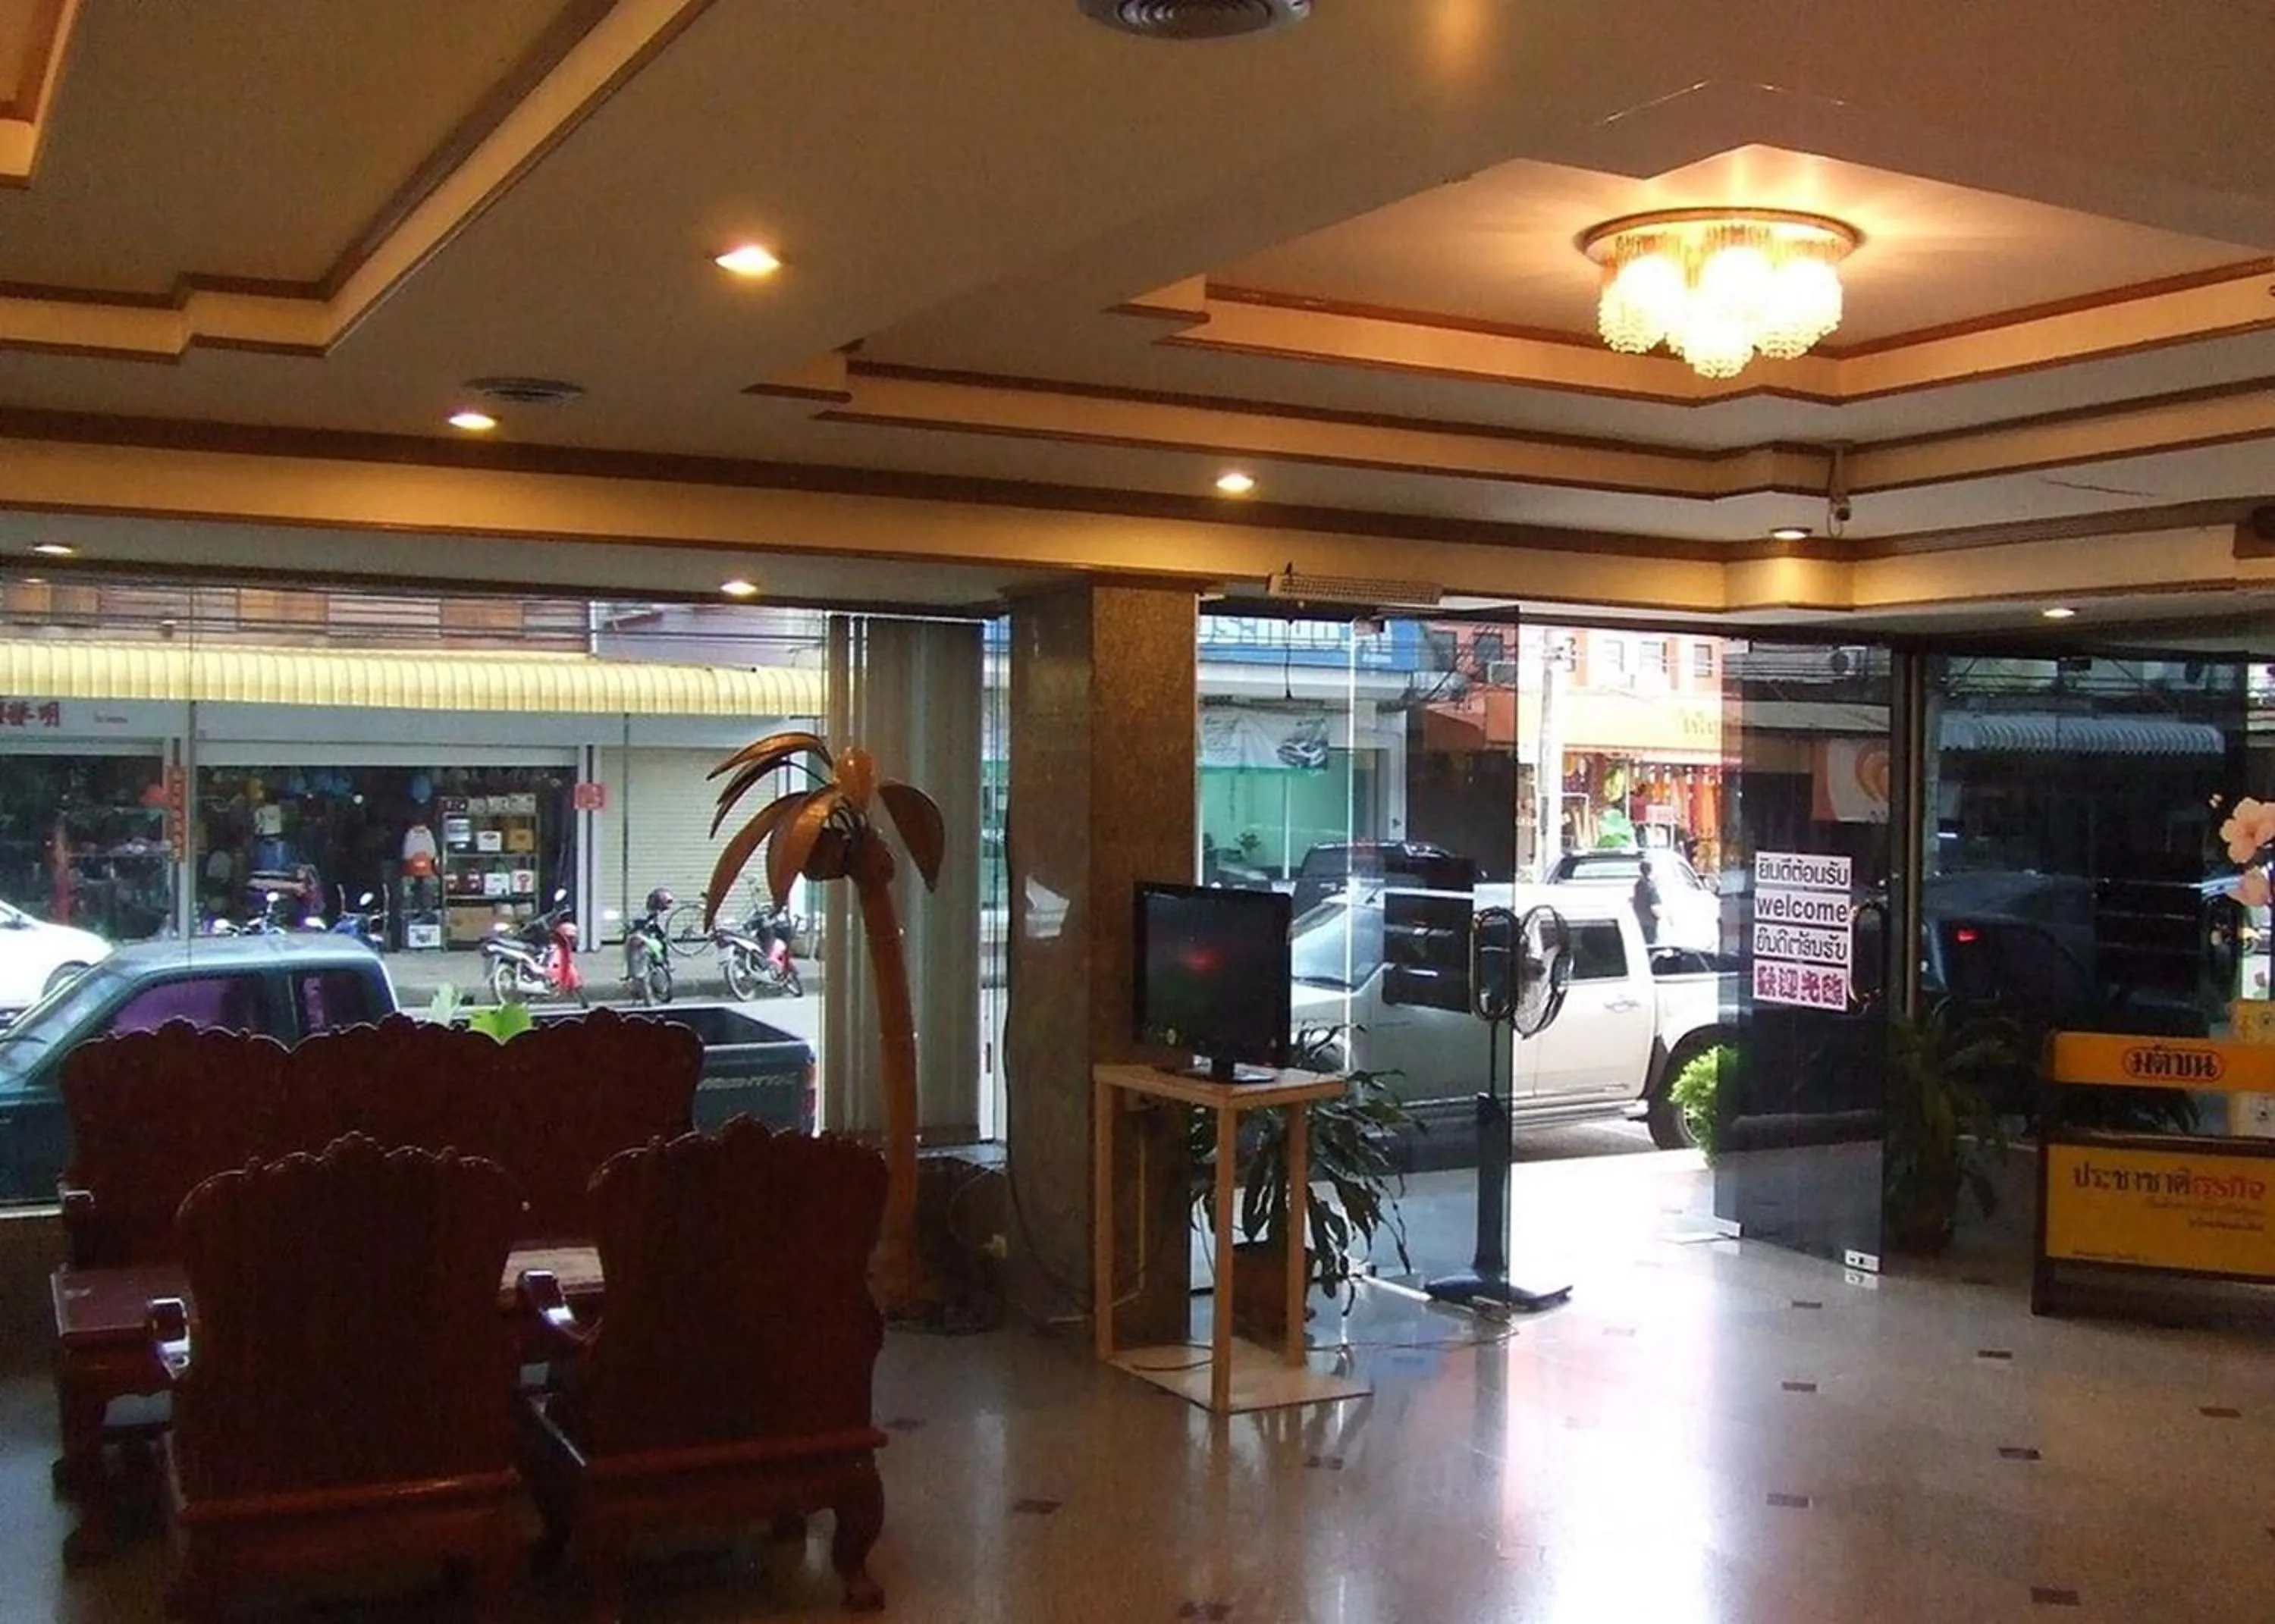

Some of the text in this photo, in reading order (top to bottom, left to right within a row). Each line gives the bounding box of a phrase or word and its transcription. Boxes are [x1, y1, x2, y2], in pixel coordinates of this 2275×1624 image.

[1758, 857, 1848, 886] ยินดีต้อนรับ
[1756, 895, 1847, 922] welcome
